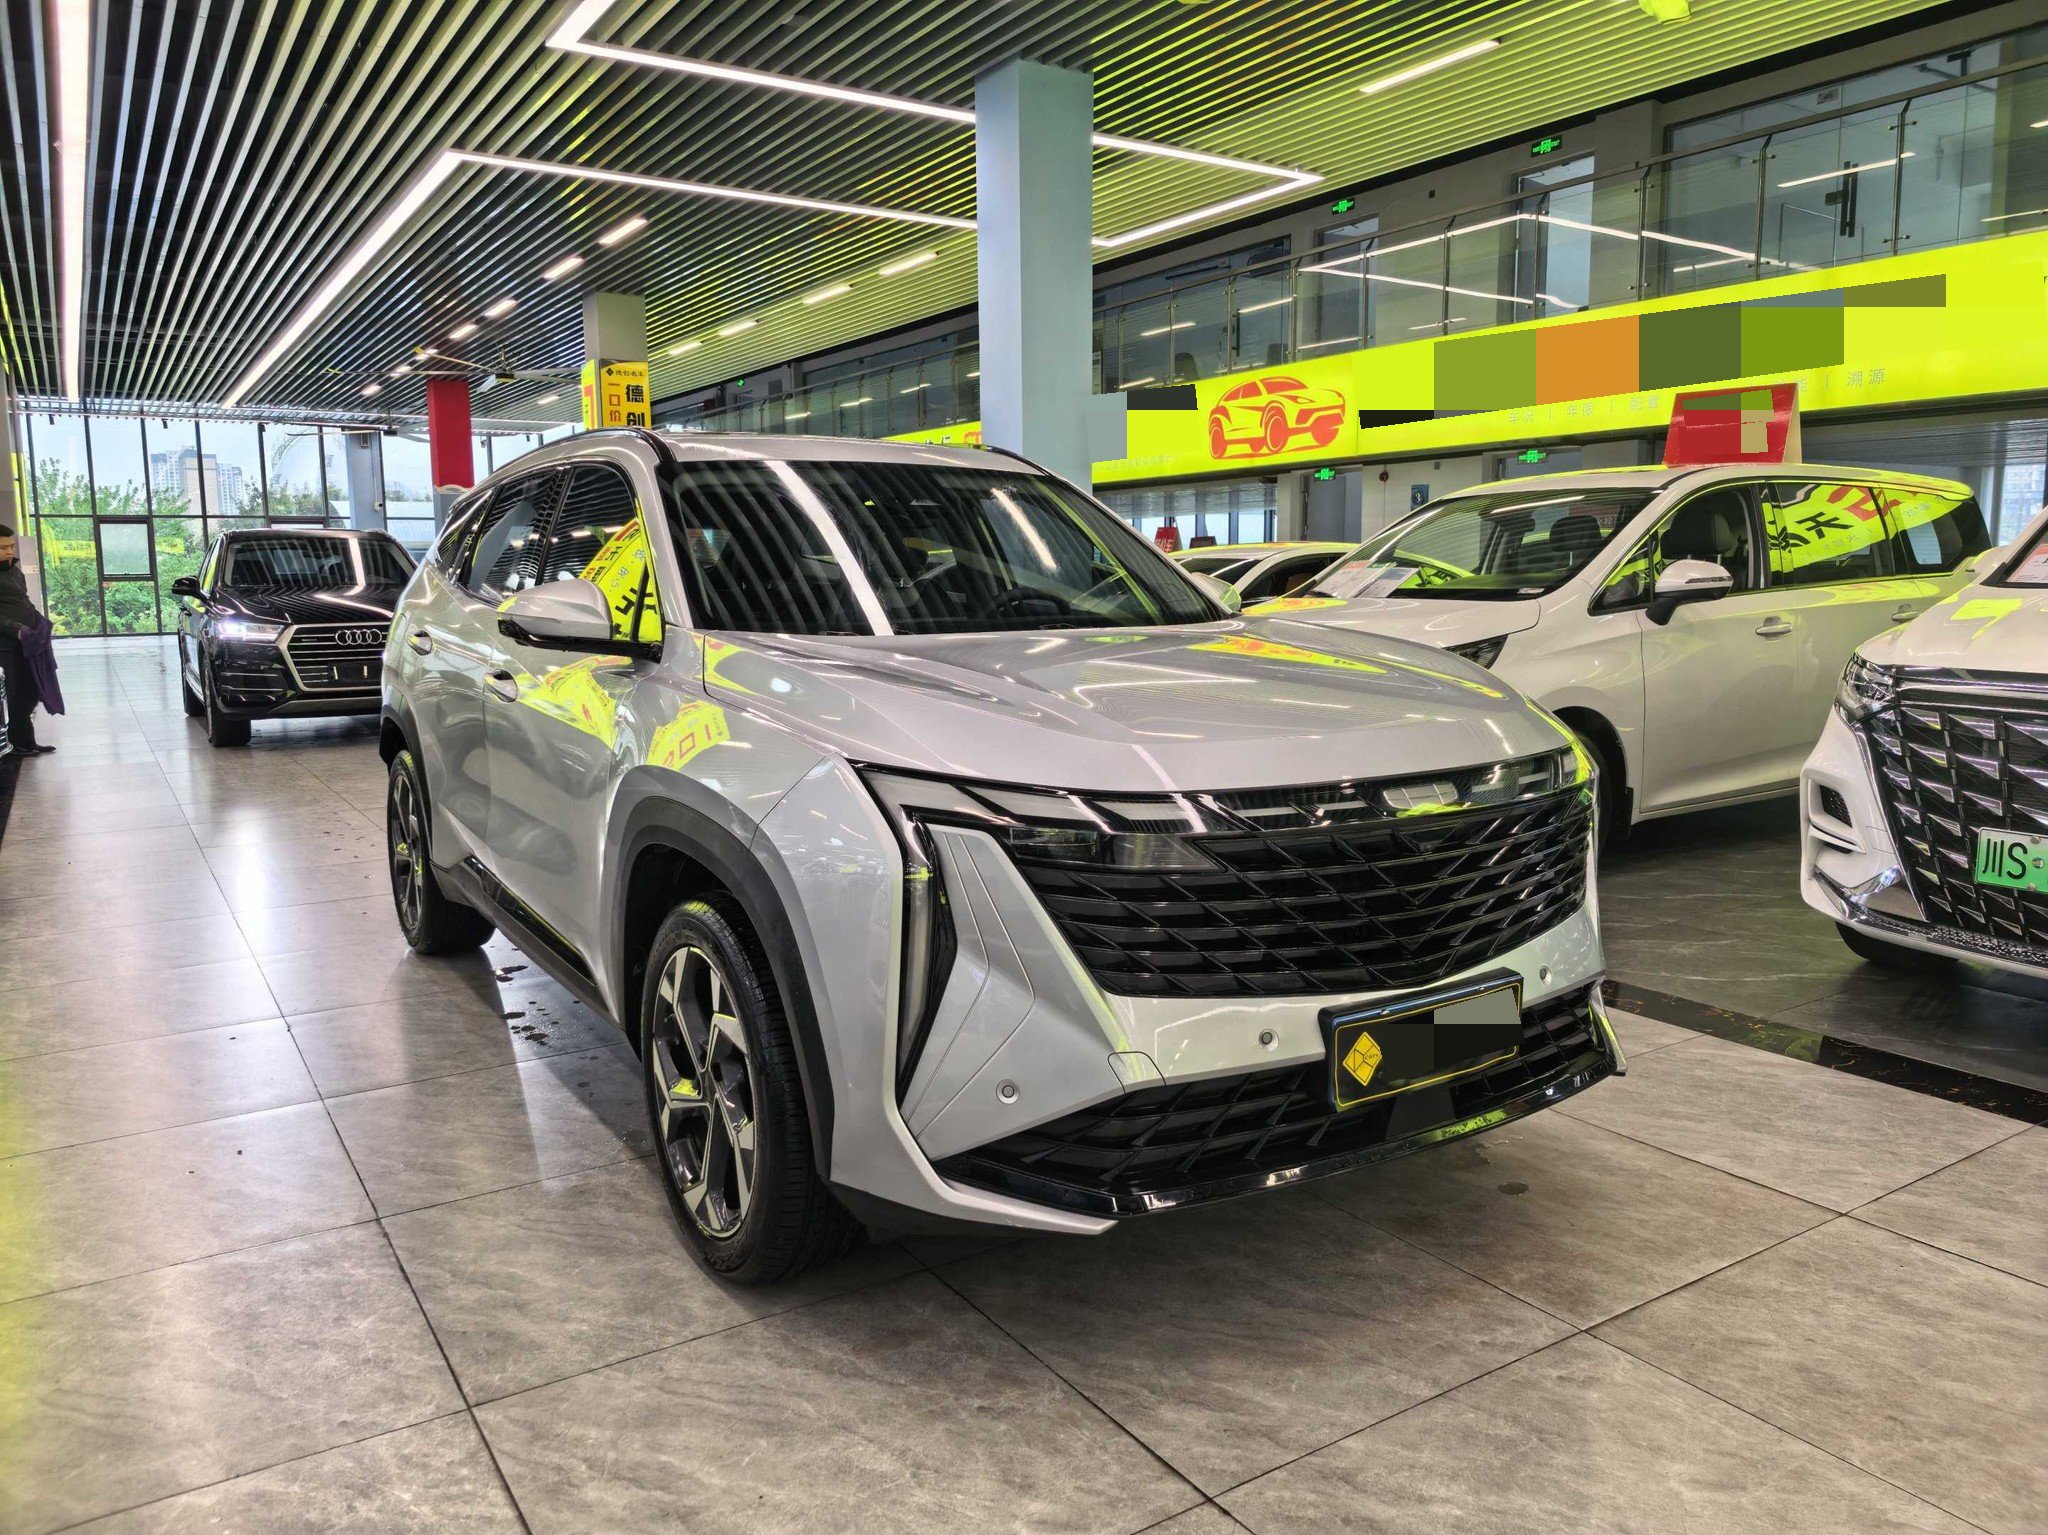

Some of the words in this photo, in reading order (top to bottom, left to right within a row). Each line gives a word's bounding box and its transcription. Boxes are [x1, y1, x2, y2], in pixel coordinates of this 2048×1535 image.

[608, 383, 621, 421] 一口价
[1567, 402, 1594, 418] 年限
[1847, 368, 1885, 387] 溯源
